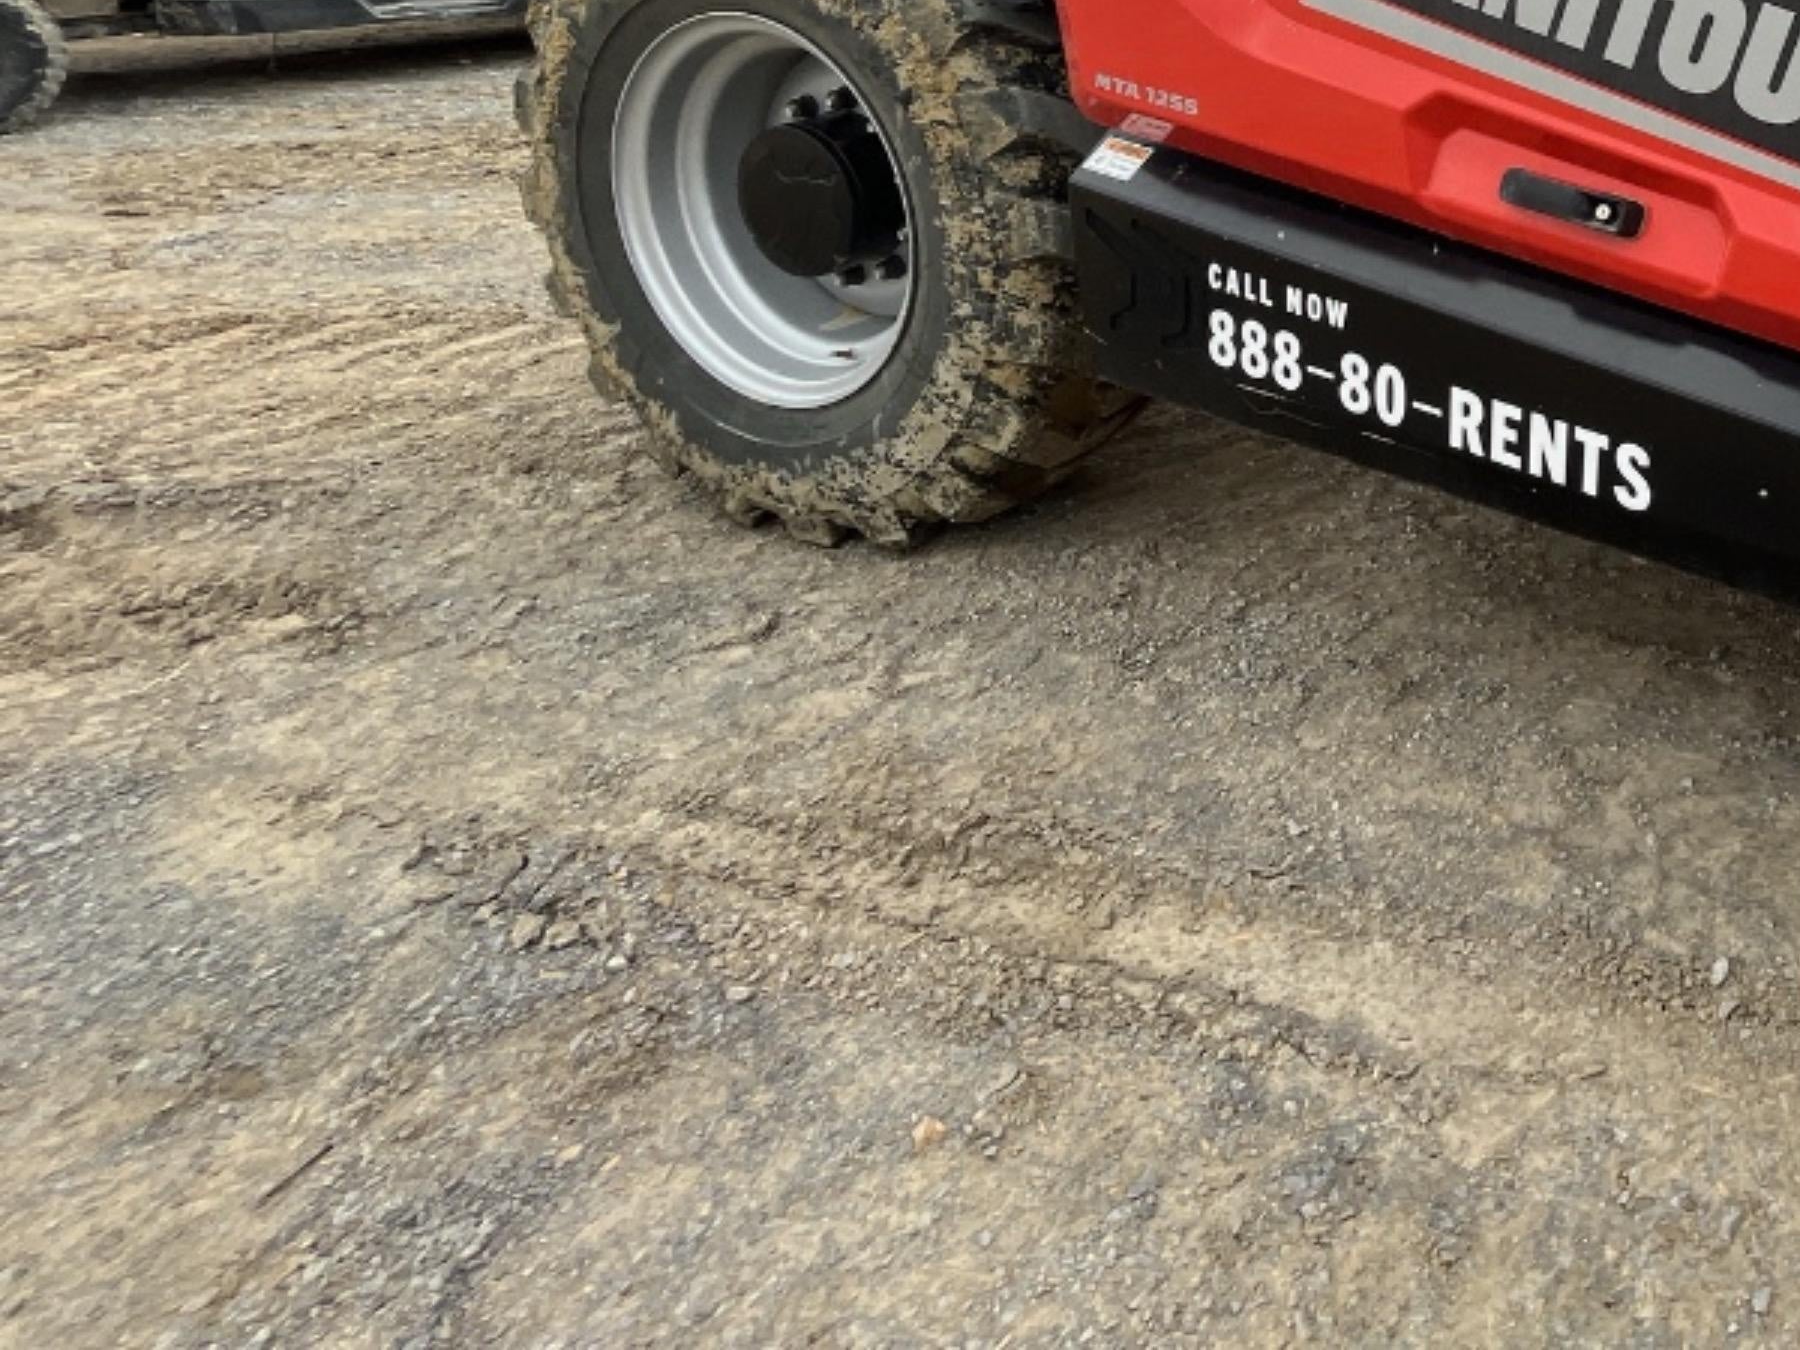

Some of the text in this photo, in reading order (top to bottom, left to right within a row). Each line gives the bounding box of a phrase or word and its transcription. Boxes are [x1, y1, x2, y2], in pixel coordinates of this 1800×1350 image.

[1094, 73, 1141, 99] MTA
[1207, 262, 1349, 330] CALL NOW
[1207, 308, 1653, 511] 888-80-RENTS
